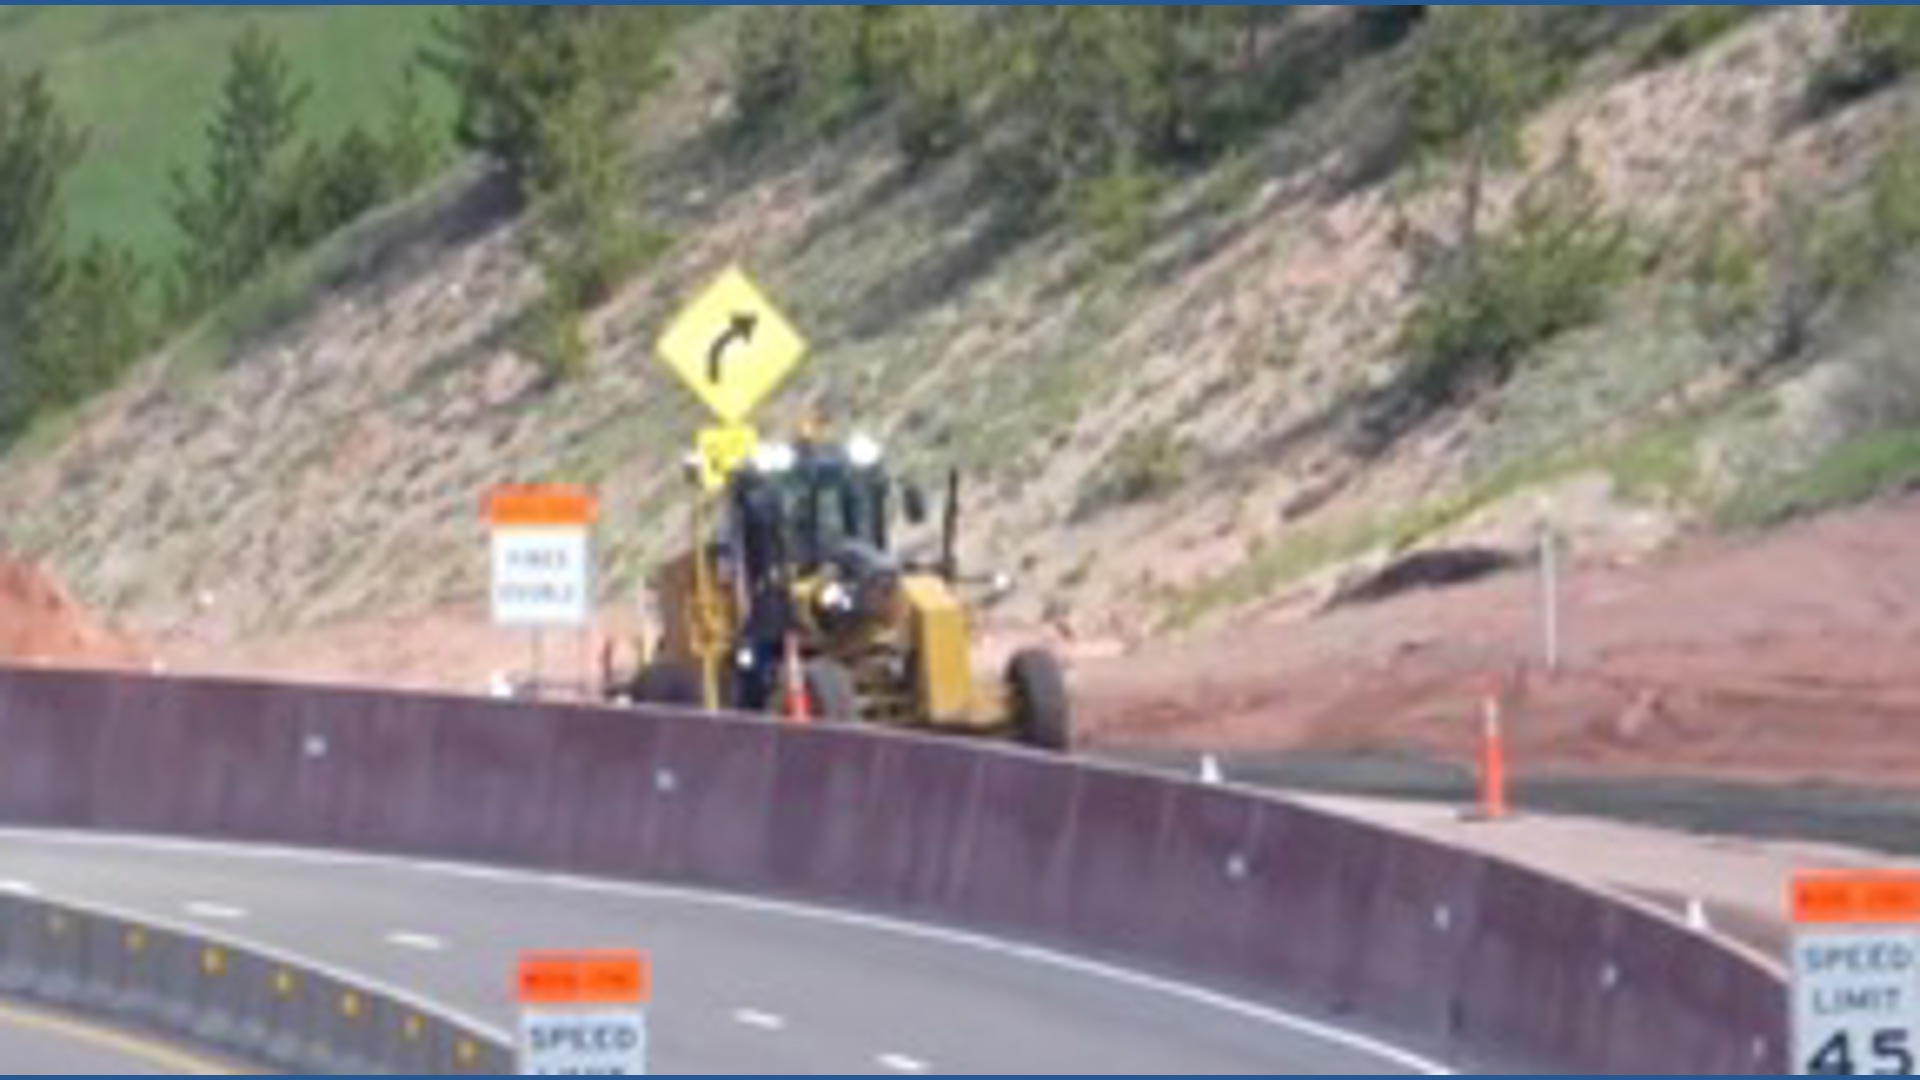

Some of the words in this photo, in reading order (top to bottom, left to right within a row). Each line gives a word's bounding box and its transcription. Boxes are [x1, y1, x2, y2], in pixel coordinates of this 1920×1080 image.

[1806, 943, 1913, 973] SPEED
[1813, 988, 1901, 1015] LIMIT
[530, 1027, 638, 1052] SPEED
[1807, 1028, 1914, 1075] 45
